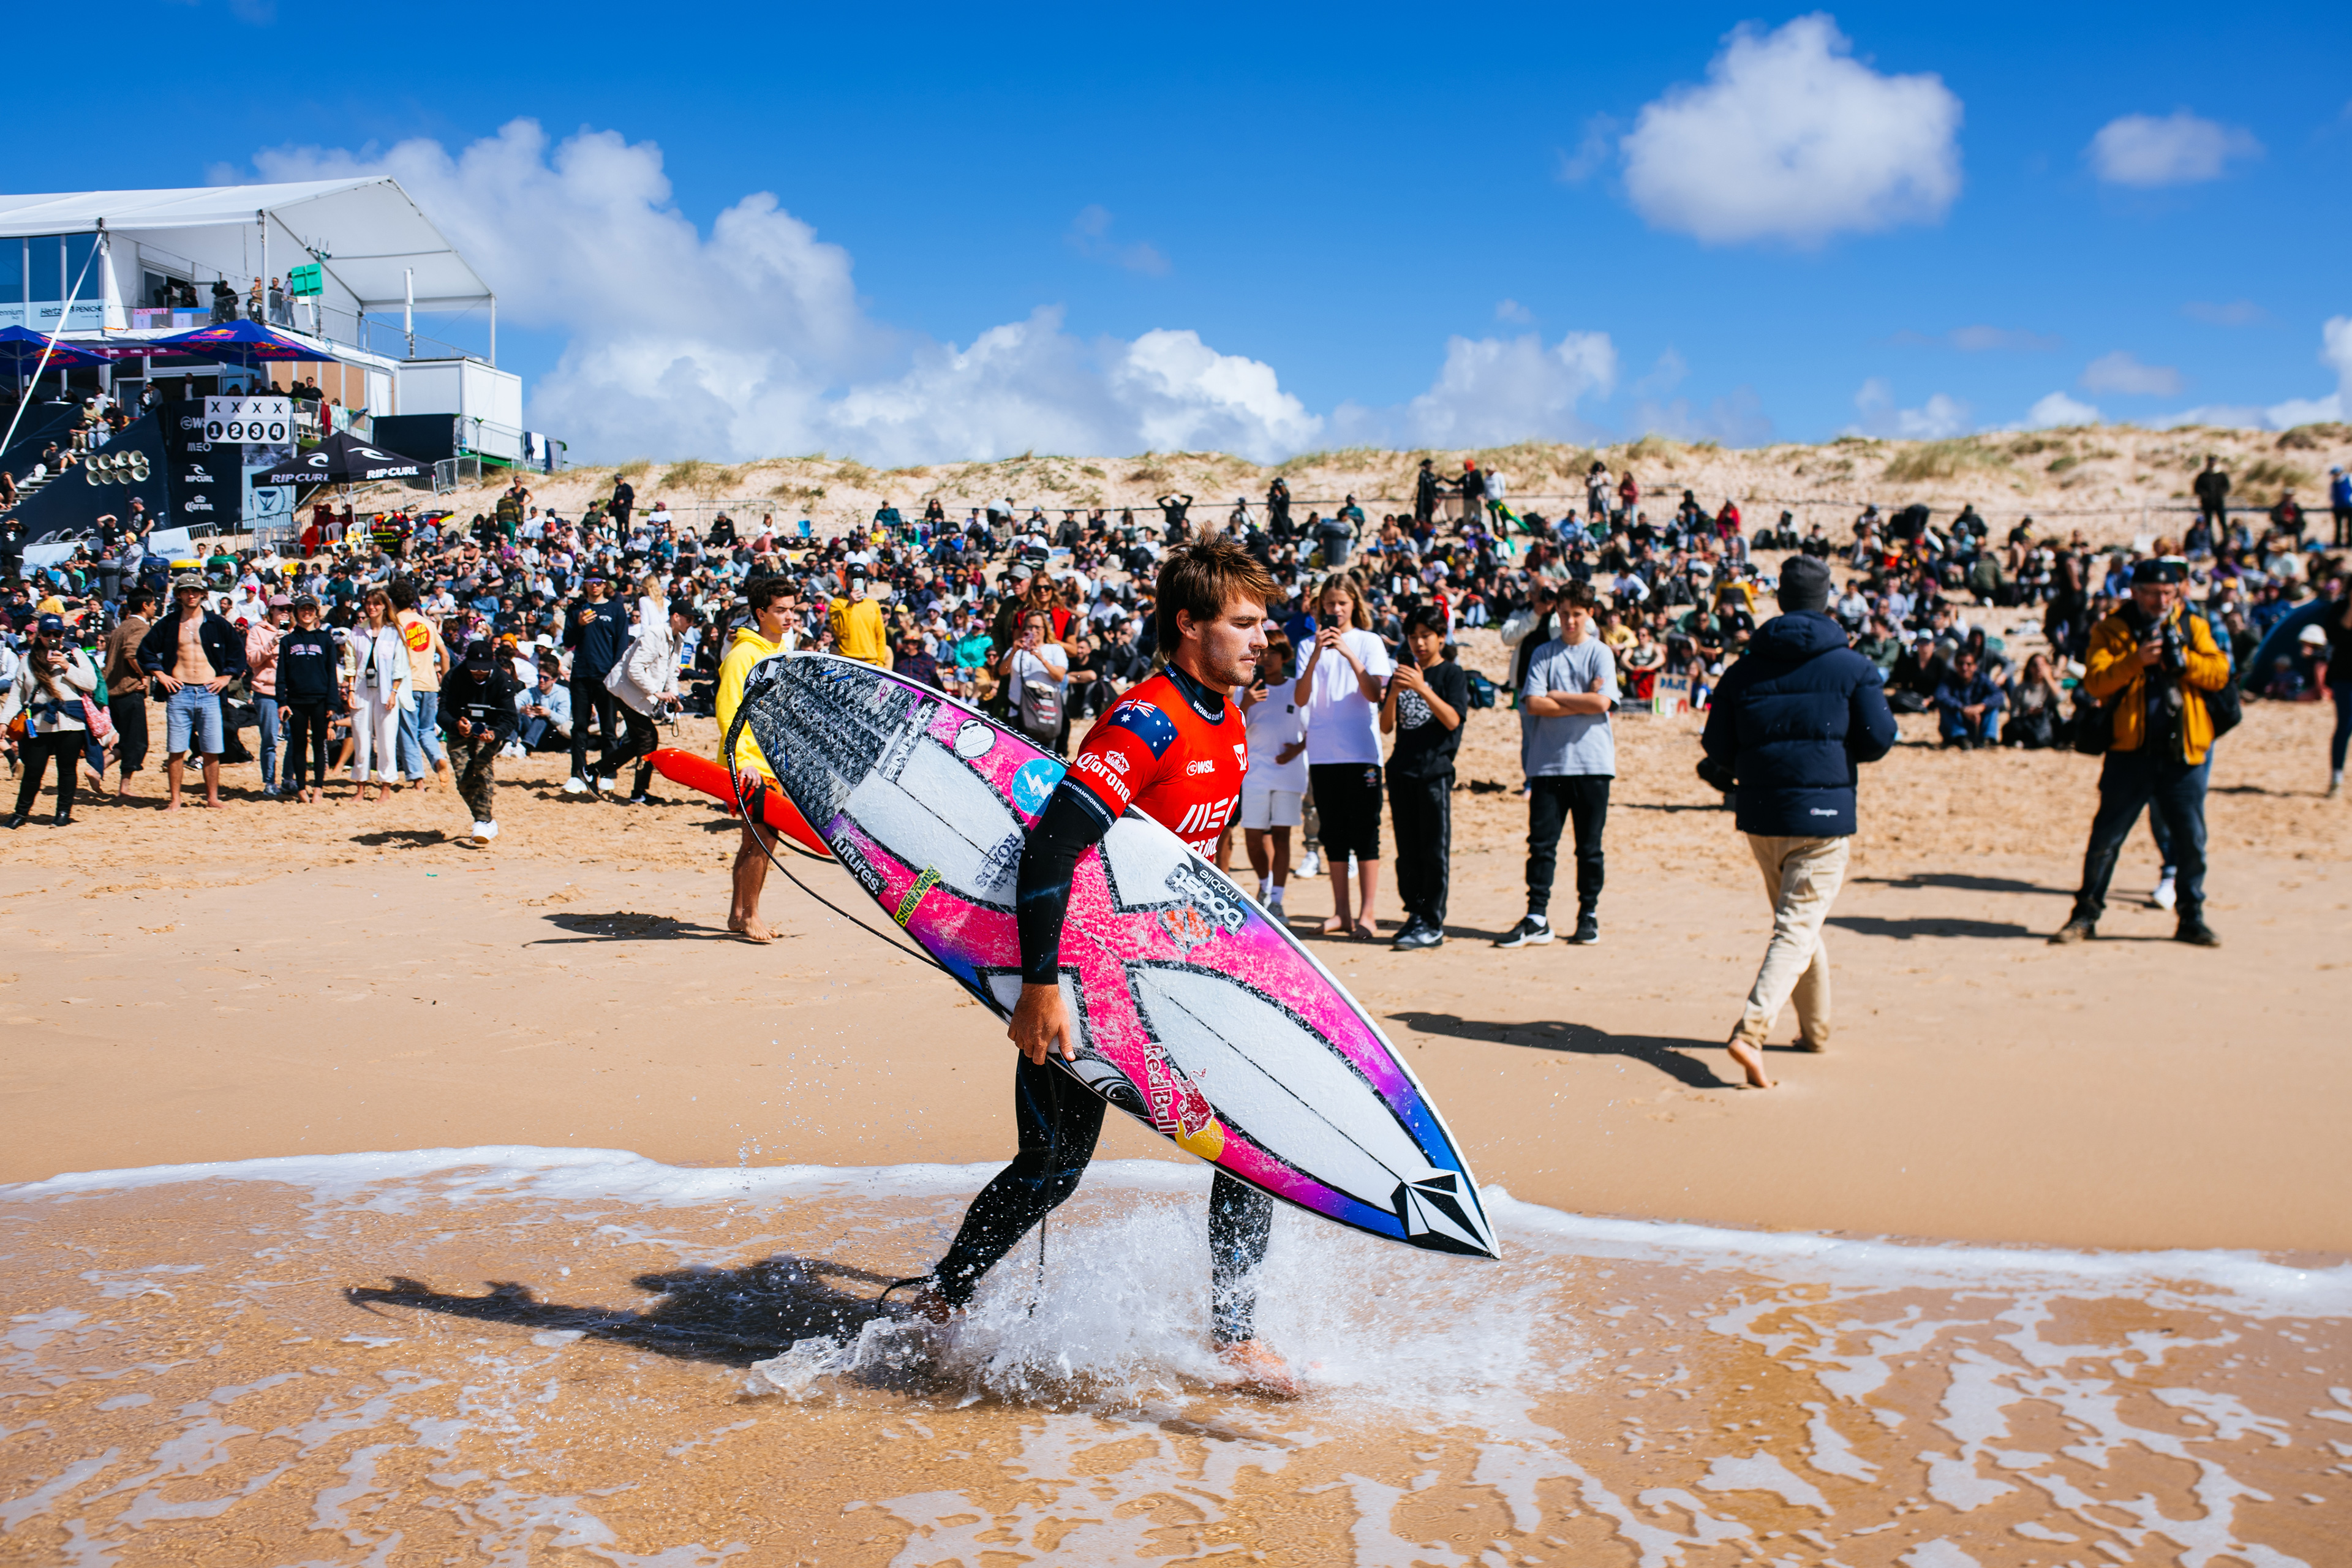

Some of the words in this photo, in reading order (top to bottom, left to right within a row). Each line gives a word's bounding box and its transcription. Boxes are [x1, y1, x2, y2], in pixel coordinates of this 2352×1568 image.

[211, 401, 221, 413] X
[231, 402, 241, 413] X
[252, 402, 262, 413] X
[273, 403, 282, 413] X
[211, 424, 219, 437] 1
[230, 424, 240, 437] 2
[251, 424, 261, 438] 3
[271, 426, 281, 439] 4
[271, 473, 295, 483] RIP
[295, 473, 330, 482] CURL
[366, 469, 385, 480] RIP
[386, 466, 419, 477] CURL
[185, 501, 214, 513] Corona
[1193, 700, 1212, 720] WORLD
[882, 703, 932, 780] DAKINE
[1076, 752, 1131, 804] Corona
[1197, 760, 1215, 774] WSL
[1061, 779, 1073, 788] 2024
[1071, 783, 1107, 816] CHAMPIONSHIP
[1104, 813, 1114, 827] TOUR
[1172, 866, 1243, 932] boost
[1199, 870, 1238, 902] mobile
[1143, 1042, 1172, 1090] Red
[1150, 1090, 1179, 1133] Bull
